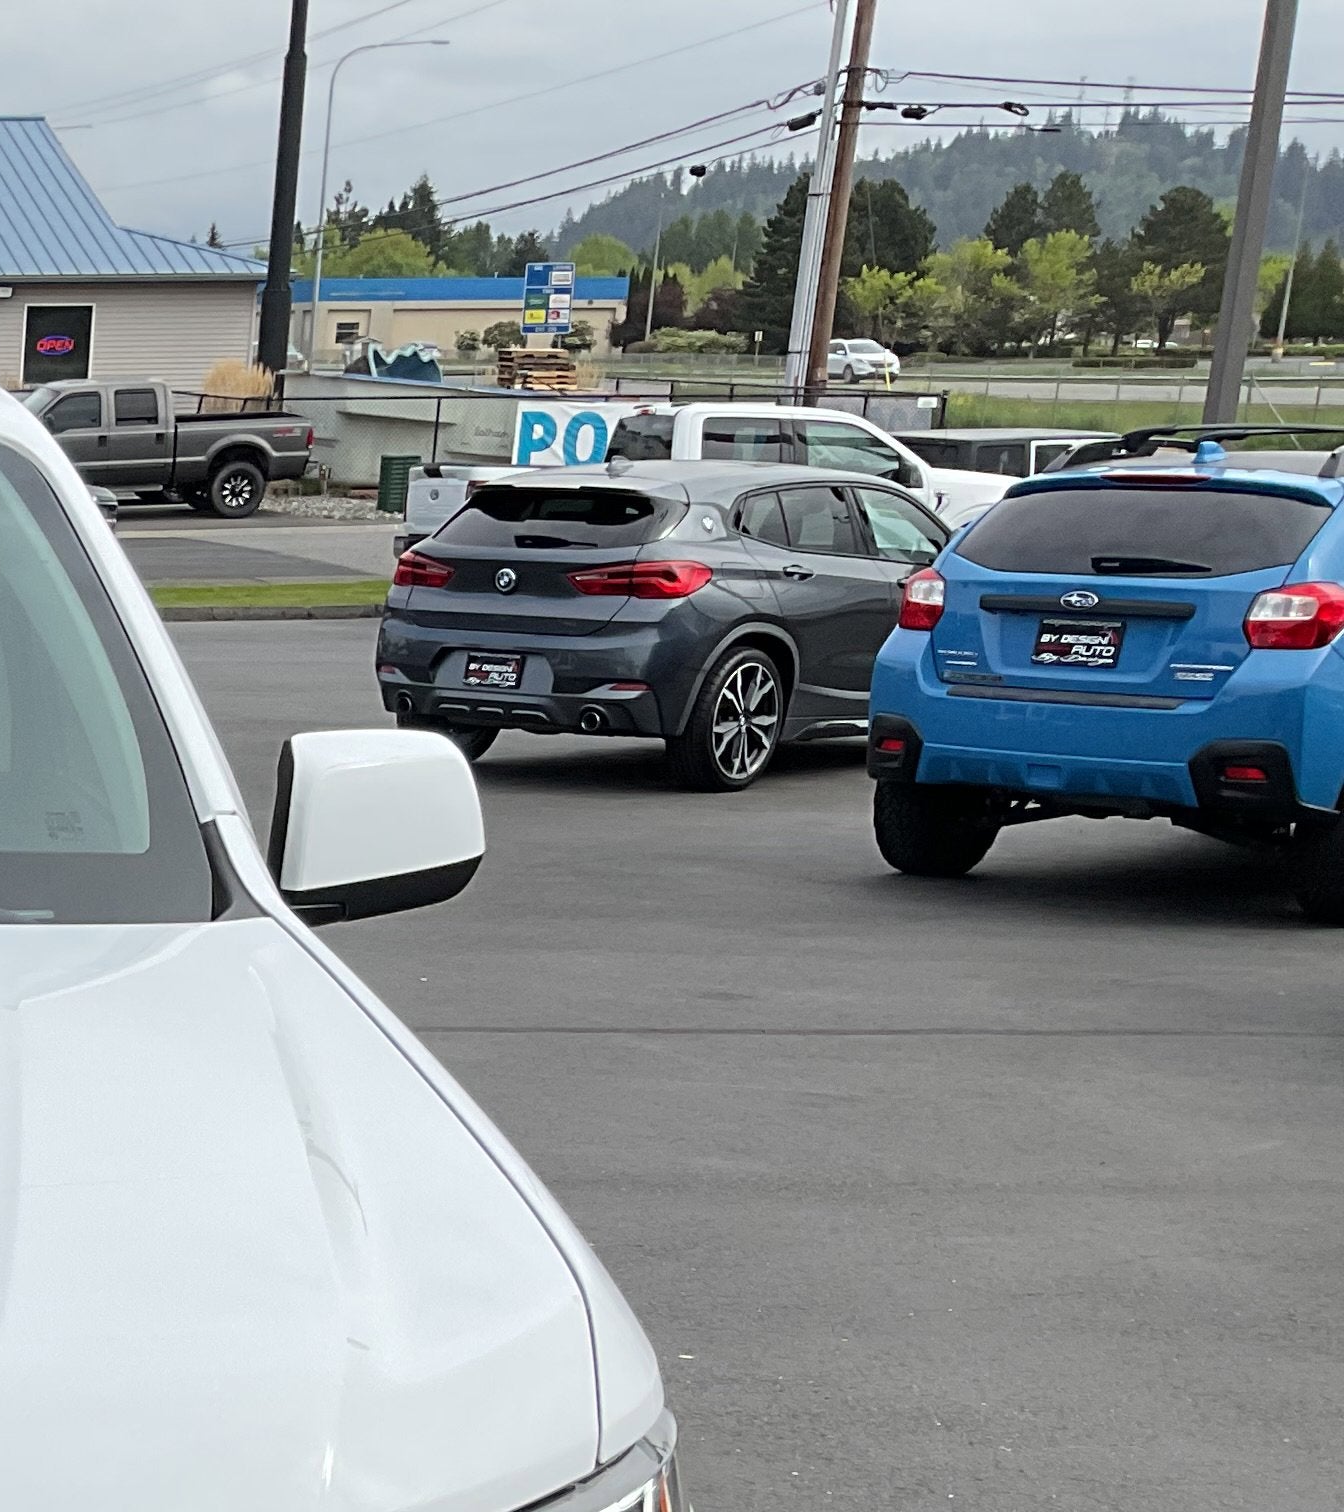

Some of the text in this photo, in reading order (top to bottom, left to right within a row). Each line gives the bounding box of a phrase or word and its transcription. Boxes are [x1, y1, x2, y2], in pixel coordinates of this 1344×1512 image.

[36, 338, 75, 351] OPEN
[1040, 633, 1110, 645] BY DESIGN
[1070, 645, 1116, 657] AUTO
[487, 672, 517, 682] AUTO
